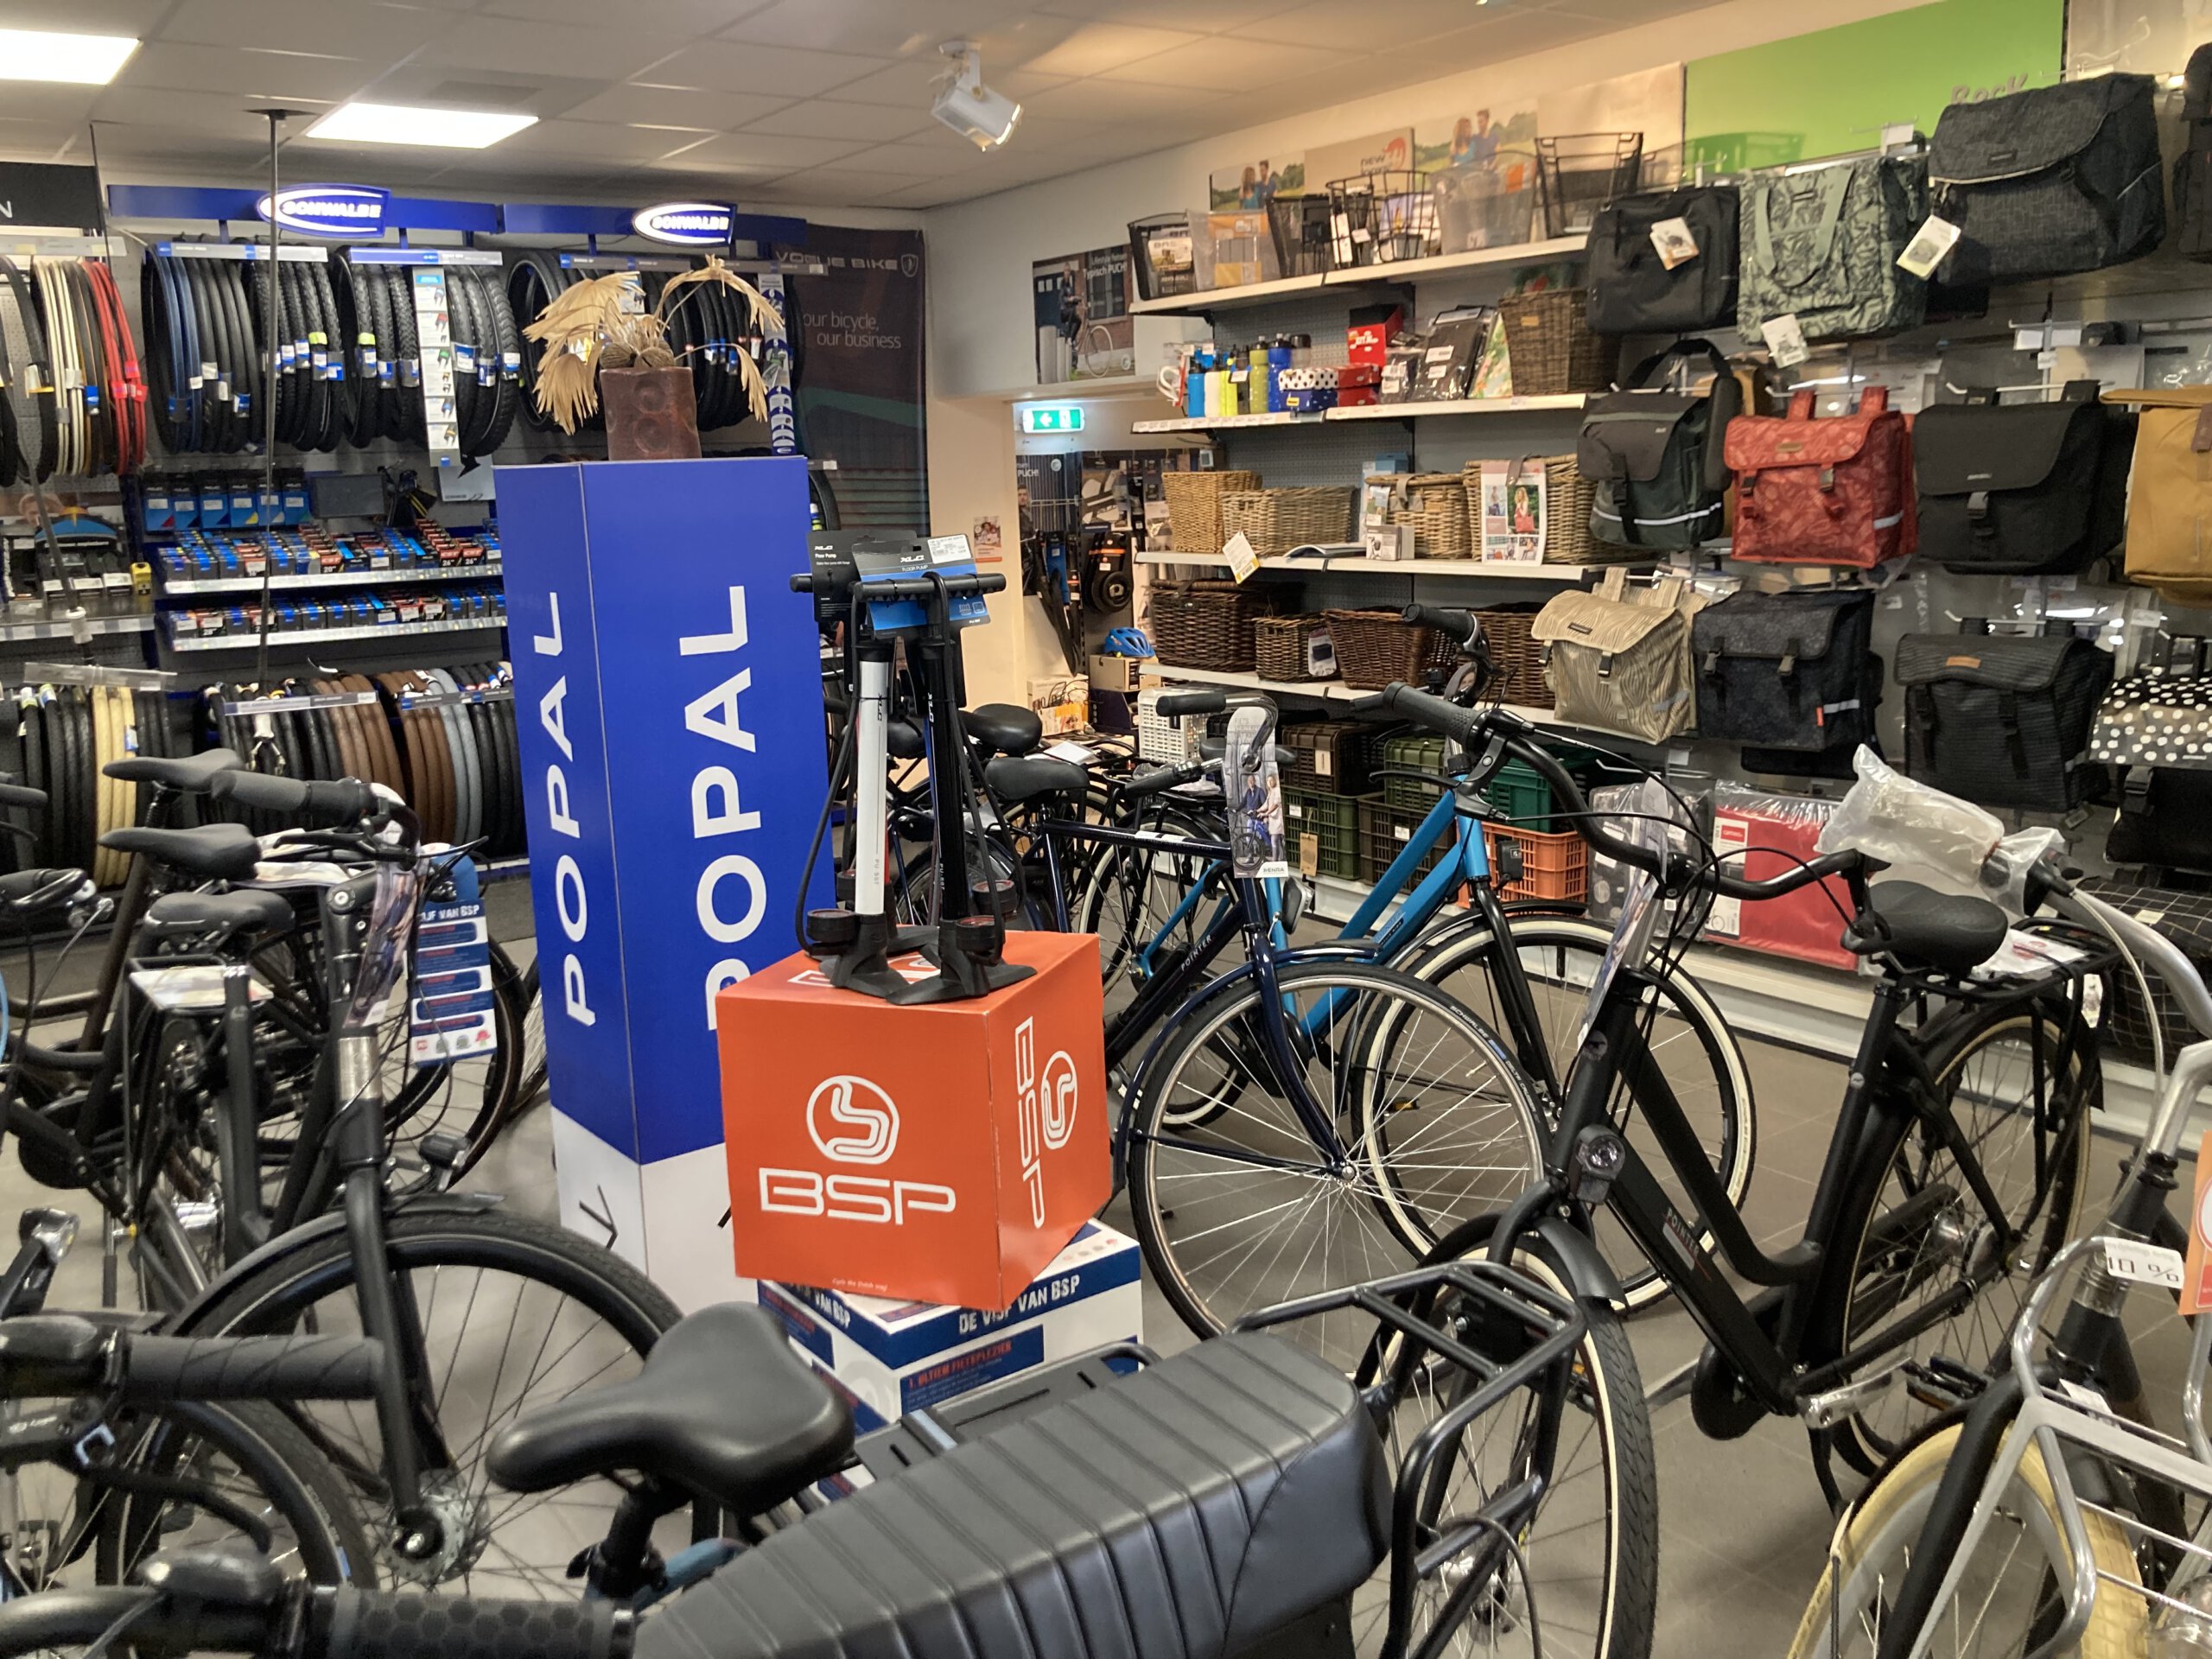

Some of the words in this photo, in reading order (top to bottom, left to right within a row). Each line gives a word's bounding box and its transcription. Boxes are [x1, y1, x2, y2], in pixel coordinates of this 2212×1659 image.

[851, 257, 899, 270] BIKE
[1083, 264, 1107, 280] Typisch
[830, 311, 880, 332] bicycle,
[817, 333, 840, 346] our
[844, 331, 901, 349] business
[899, 555, 925, 563] XLC
[534, 592, 595, 1027] POPAL
[439, 907, 460, 920] VAN
[461, 904, 479, 916] BSP
[1180, 934, 1212, 972] POINTER
[1014, 1016, 1045, 1229] BSP
[759, 1167, 957, 1225] BSP
[1666, 1207, 1700, 1259] POINTER
[2148, 1264, 2179, 1282] %
[815, 1291, 833, 1316] VAN
[833, 1299, 851, 1329] BSP
[959, 1313, 977, 1336] DE
[1018, 1287, 1048, 1314] VAN
[1051, 1274, 1080, 1301] BSP
